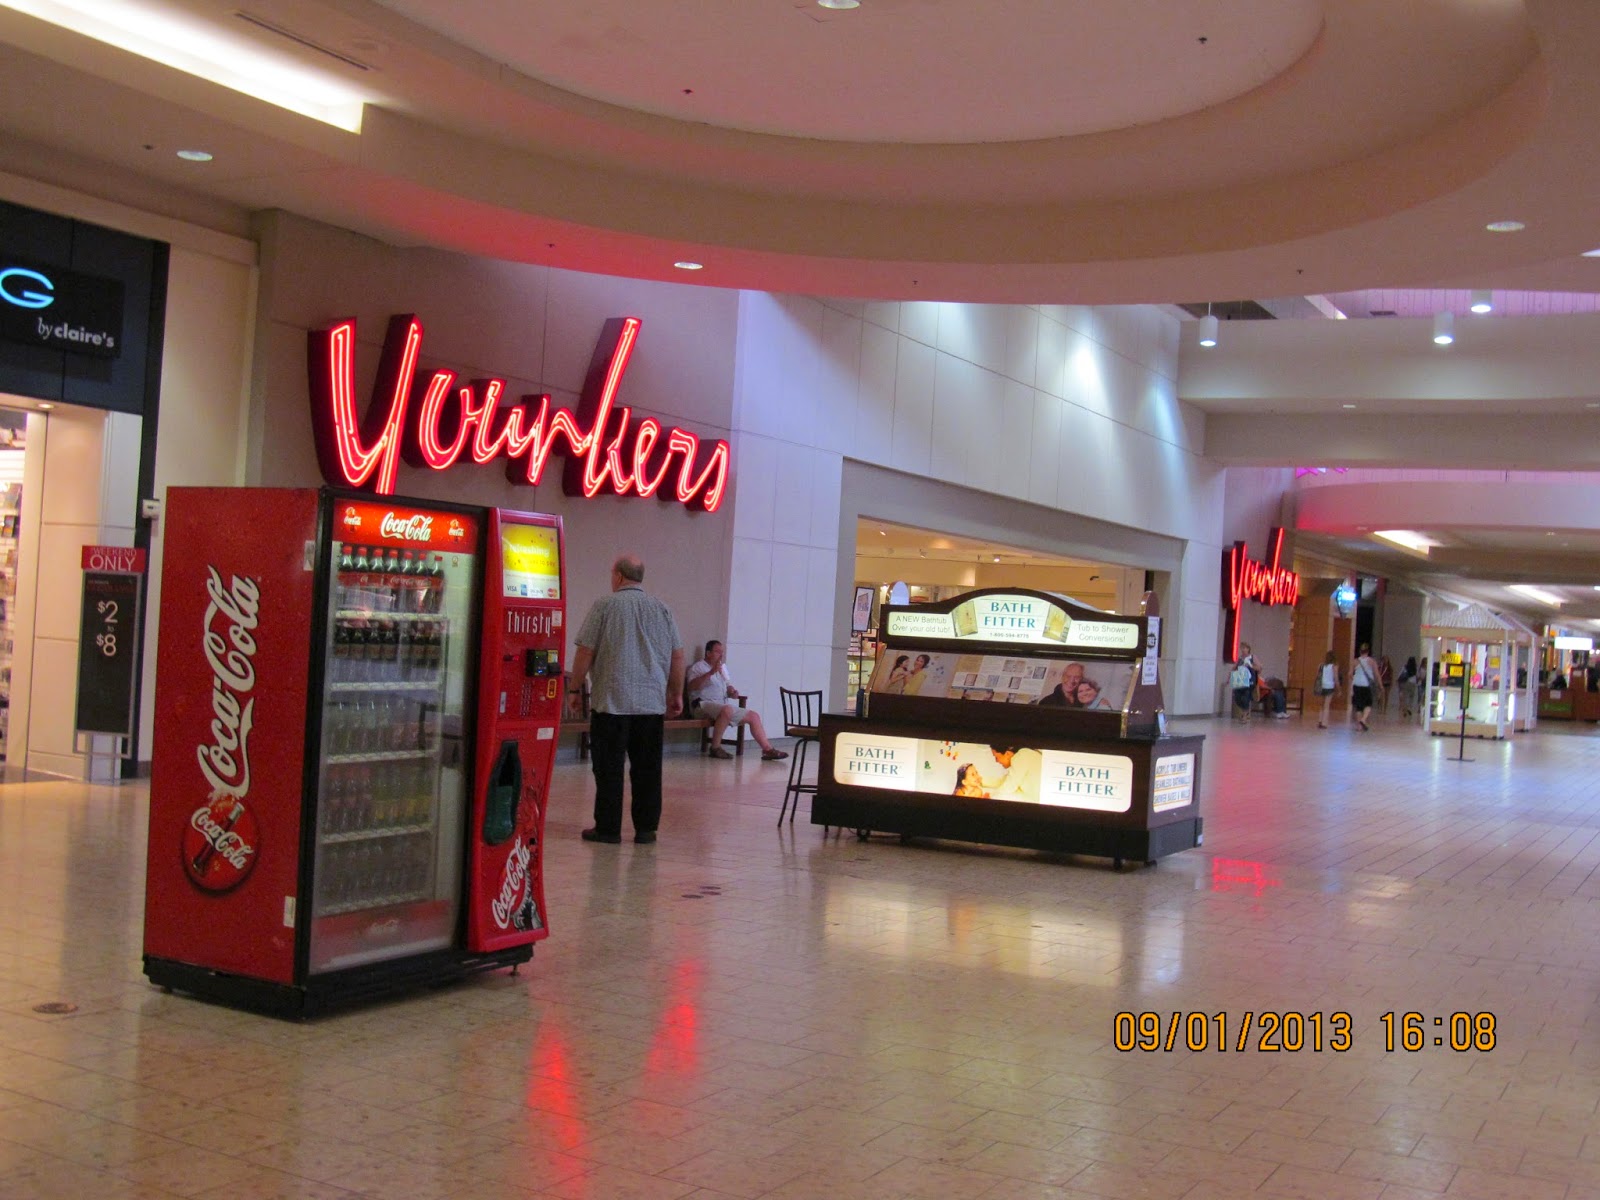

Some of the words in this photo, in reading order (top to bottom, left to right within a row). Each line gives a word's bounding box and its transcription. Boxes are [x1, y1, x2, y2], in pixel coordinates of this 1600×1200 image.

[37, 316, 53, 340] by
[54, 322, 115, 348] claire's
[329, 315, 731, 513] Younkers
[380, 511, 434, 542] Coca-Cola
[93, 547, 137, 558] WEEKEND
[90, 554, 136, 572] ONLY
[506, 585, 518, 593] VISA
[1230, 526, 1299, 663] Younkers
[97, 600, 118, 623] $2
[990, 601, 1032, 613] BATH
[902, 615, 920, 623] NEW
[921, 616, 947, 624] Bathtub
[984, 616, 1036, 628] FITTER
[891, 623, 908, 631] Over
[910, 625, 925, 633] your
[926, 625, 936, 633] old
[1077, 623, 1091, 632] Tub
[1092, 624, 1100, 632] to
[1101, 625, 1130, 633] Shower
[96, 633, 117, 657] $8
[1078, 633, 1126, 643] Conversions!
[196, 563, 261, 800] Coca-Cola
[855, 746, 895, 760] BATH
[849, 760, 899, 775] FITTER
[1065, 766, 1110, 780] BATH
[1058, 780, 1114, 796] FITTER
[191, 806, 254, 869] Coca-Cola
[491, 835, 531, 930] Coca-Cola
